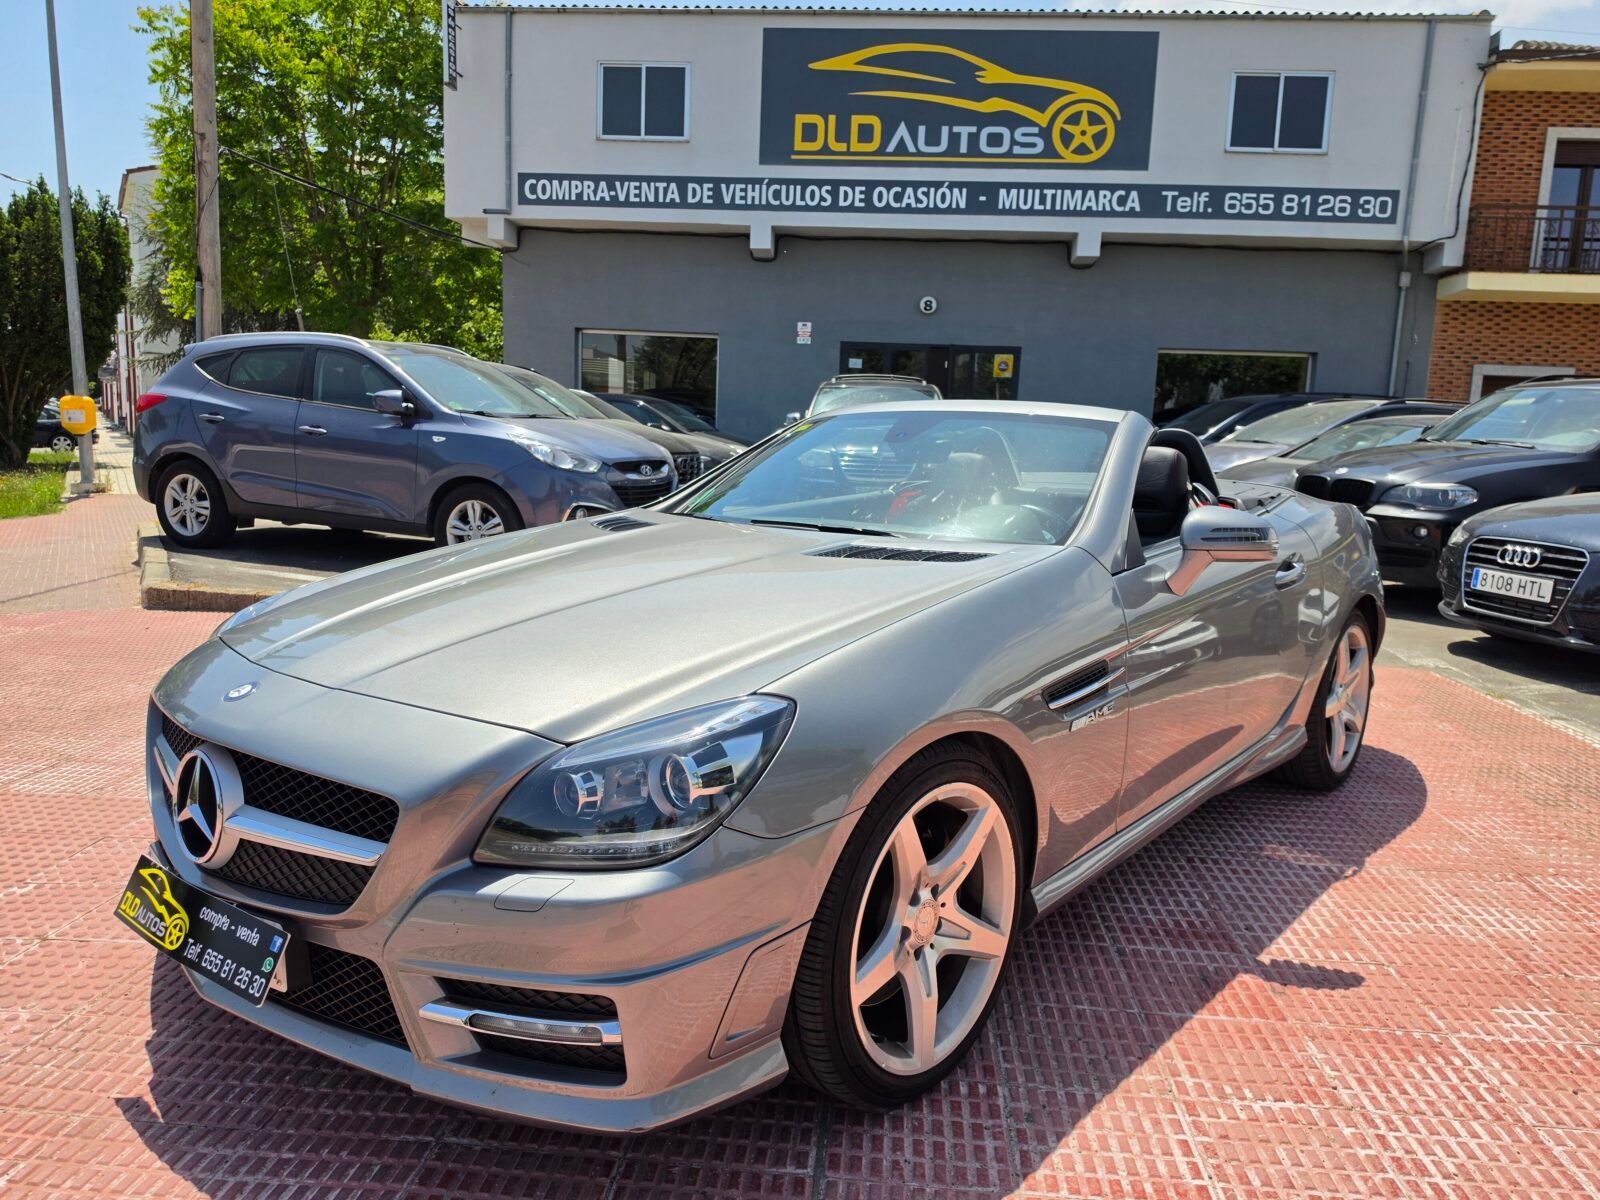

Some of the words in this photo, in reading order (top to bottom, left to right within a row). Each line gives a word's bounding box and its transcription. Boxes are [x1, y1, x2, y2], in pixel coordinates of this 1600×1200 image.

[793, 114, 882, 152] DLD
[885, 120, 1045, 154] AUTOS
[524, 178, 680, 203] COMPRA-VENTA
[687, 183, 714, 204] DE
[721, 179, 832, 206] VEHÍCULOS
[838, 186, 866, 207] DE
[872, 182, 967, 209] OCASIÓN
[998, 188, 1141, 212] MULTIMARCA
[1161, 191, 1212, 213] Telf.
[1224, 192, 1275, 215] 655
[1358, 196, 1393, 218] 30
[923, 300, 933, 311] 8
[1480, 572, 1513, 592] 8108
[1517, 578, 1546, 599] HTL
[120, 891, 141, 917] DLD
[135, 905, 166, 937] AUTOS
[200, 906, 230, 931] compra
[236, 925, 260, 947] venta
[184, 938, 203, 962] Telf.
[201, 948, 224, 973] 655
[220, 959, 237, 981] 81
[234, 966, 252, 989] 26
[248, 975, 266, 998] 30
